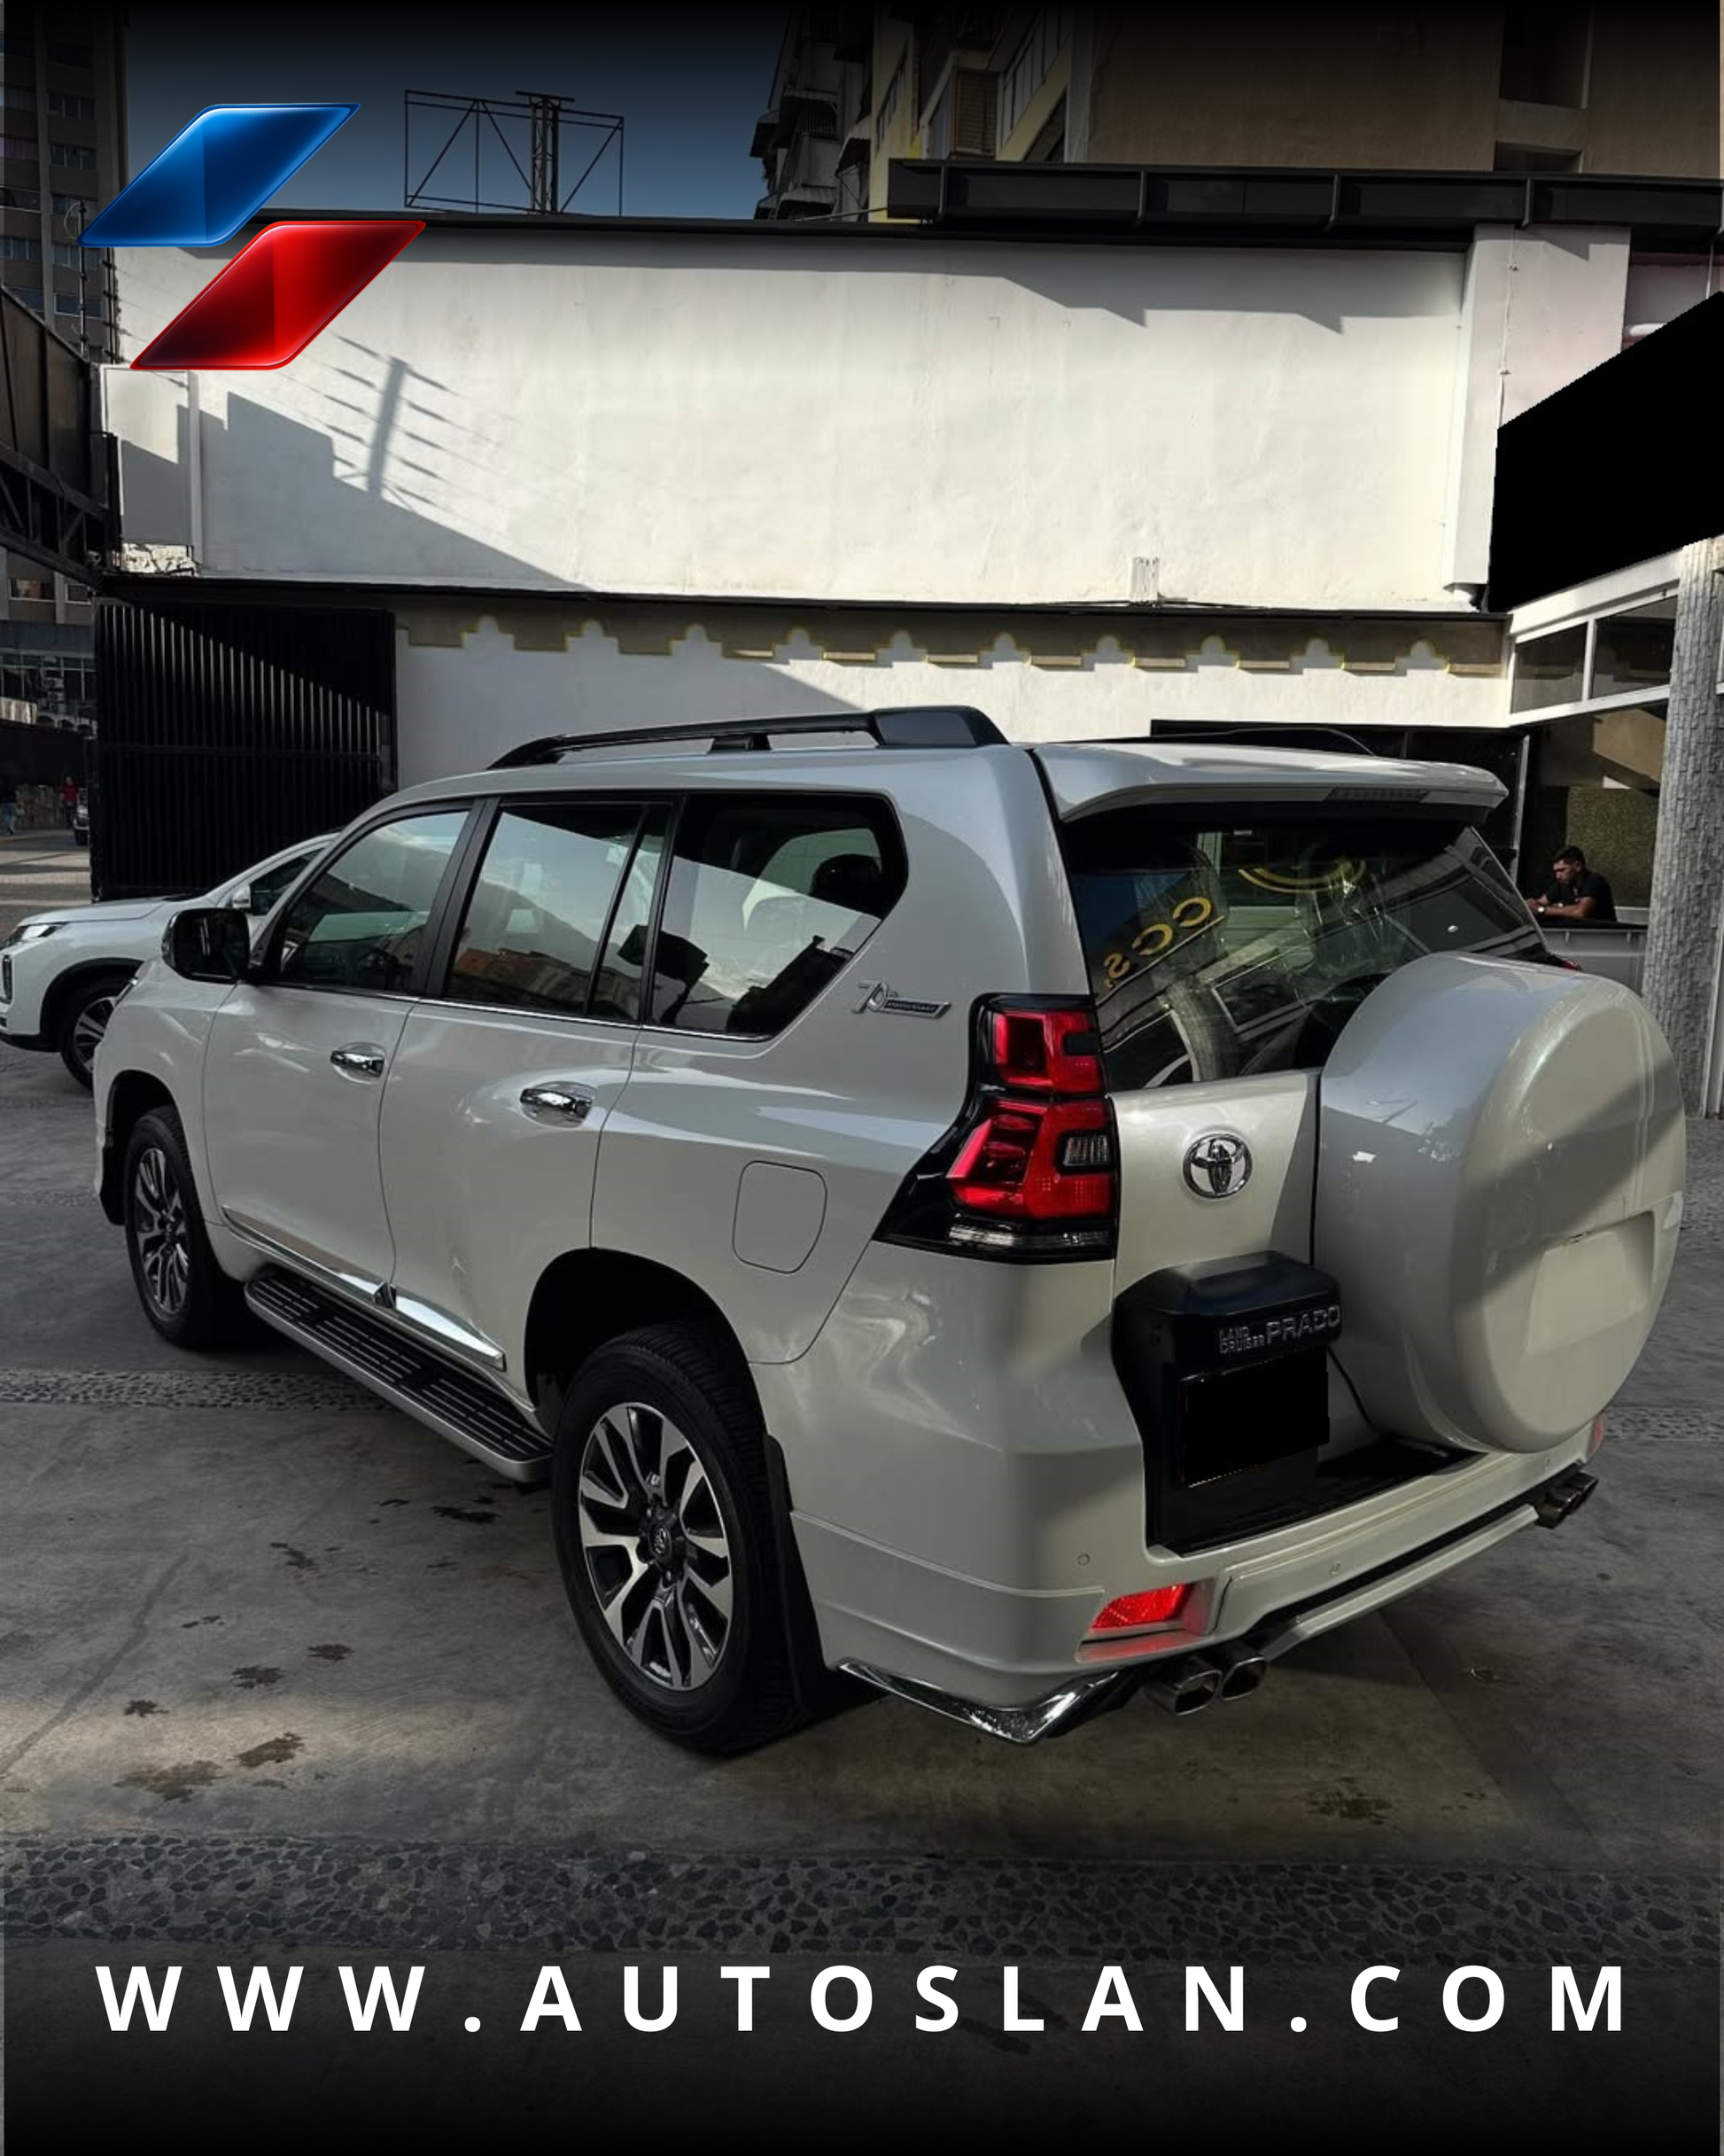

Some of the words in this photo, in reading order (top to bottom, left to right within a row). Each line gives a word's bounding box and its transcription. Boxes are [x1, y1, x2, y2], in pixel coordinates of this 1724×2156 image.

[1266, 1304, 1340, 1344] PRADO
[1218, 1326, 1250, 1342] LAND
[1218, 1335, 1265, 1354] CRUISER
